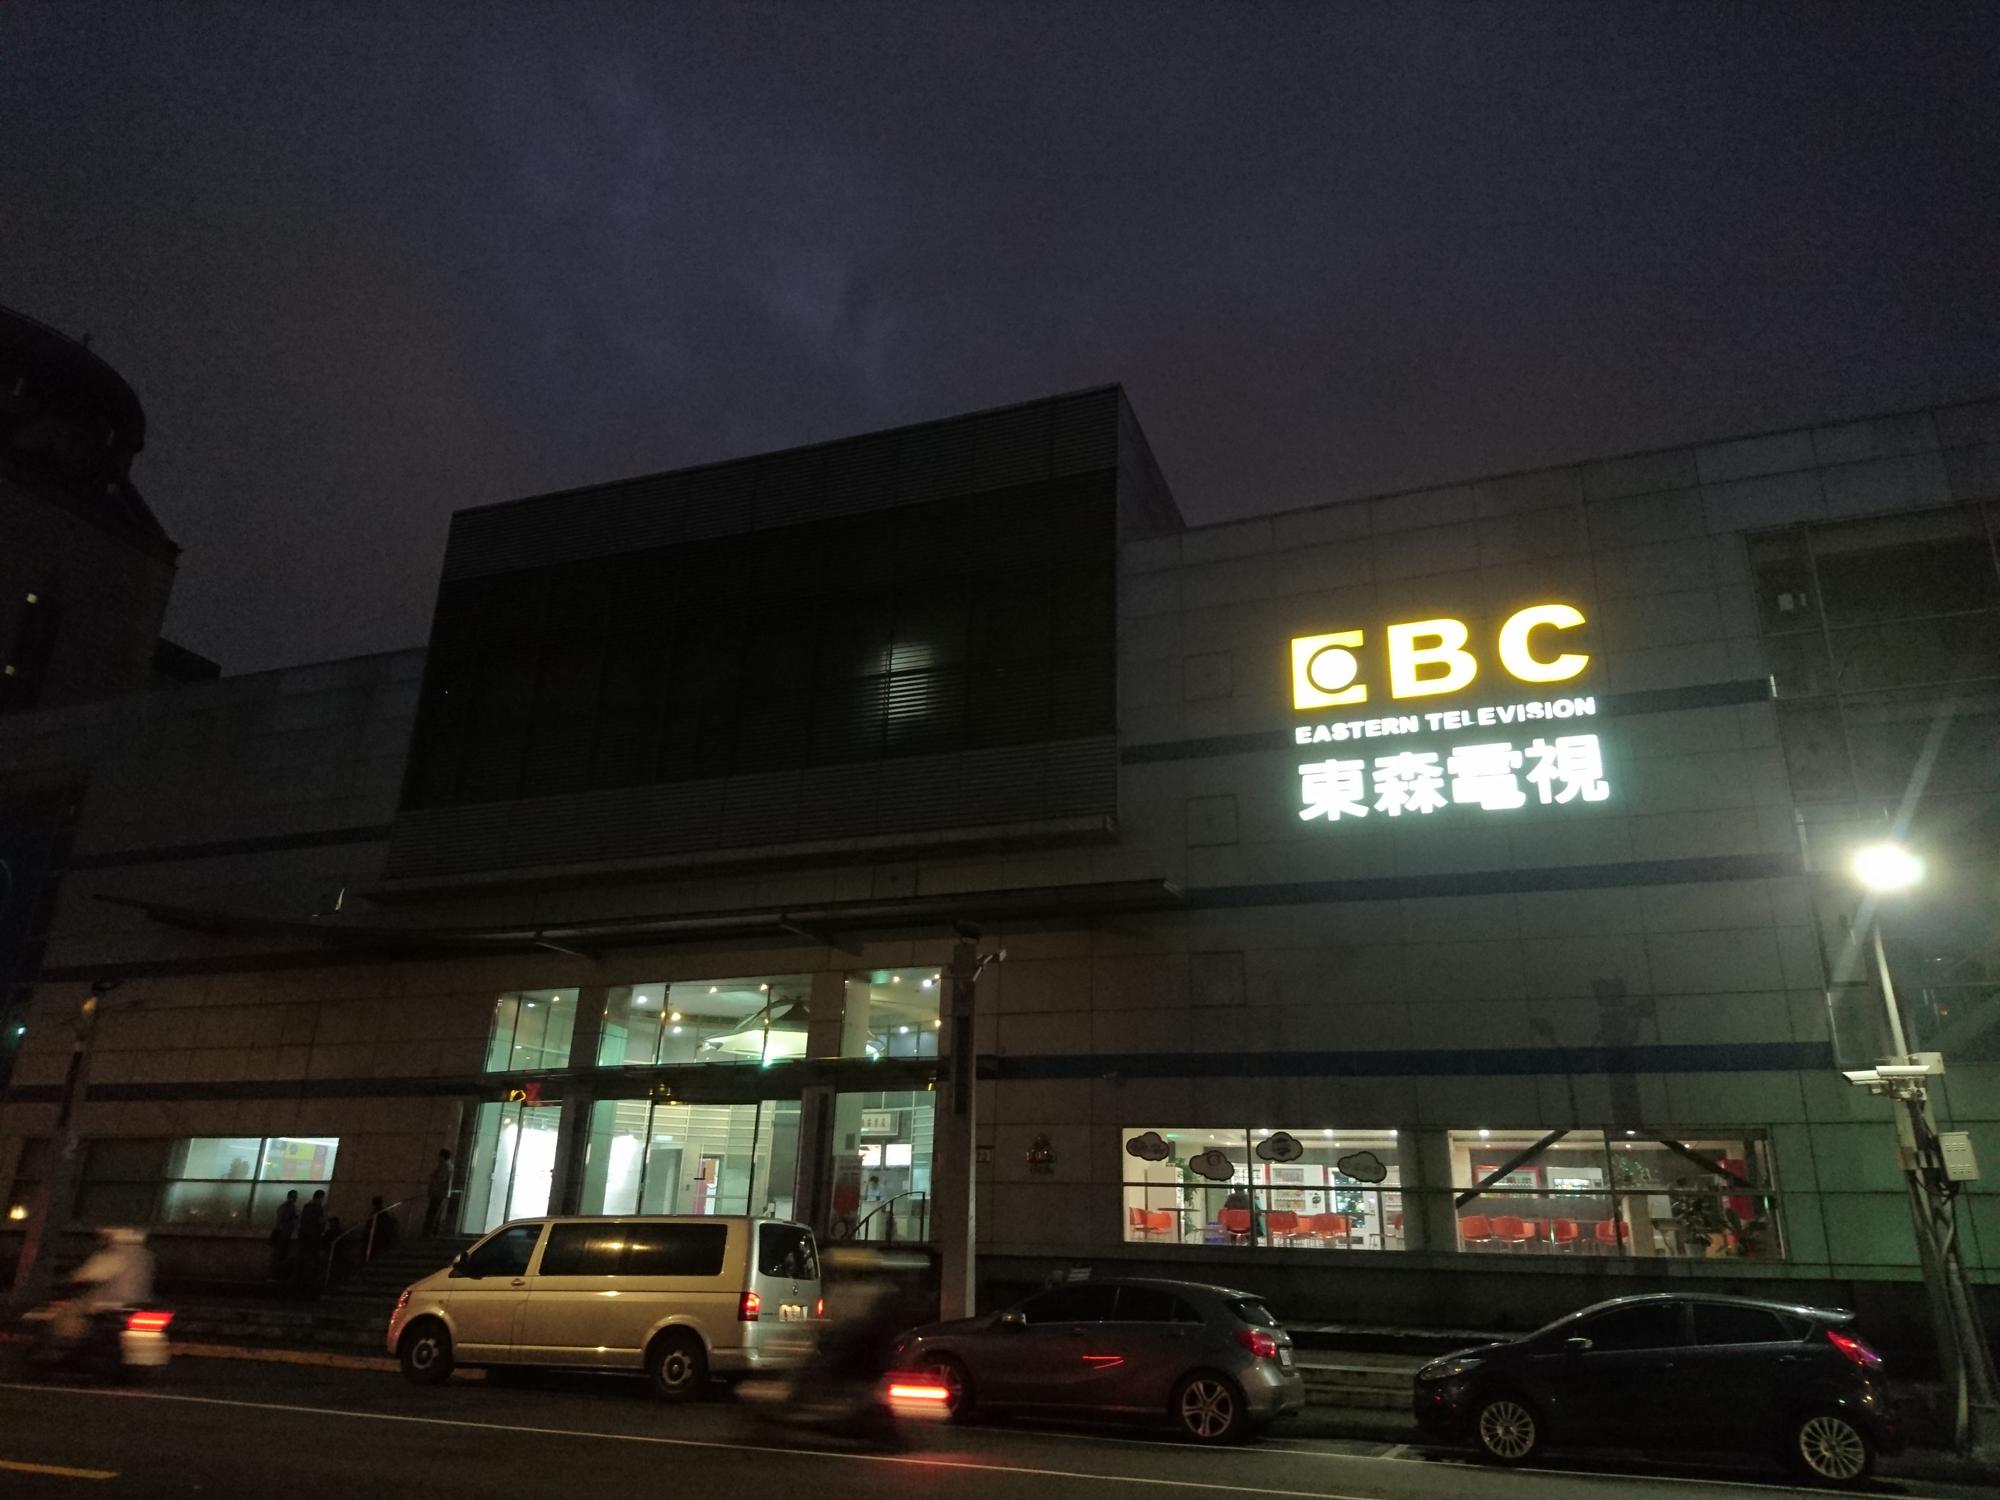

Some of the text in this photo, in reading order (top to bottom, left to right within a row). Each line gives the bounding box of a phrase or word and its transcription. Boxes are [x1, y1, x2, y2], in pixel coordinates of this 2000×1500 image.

[1295, 697, 1596, 744] EASTERN TELEVISION
[1298, 734, 1610, 821] 東森電視
